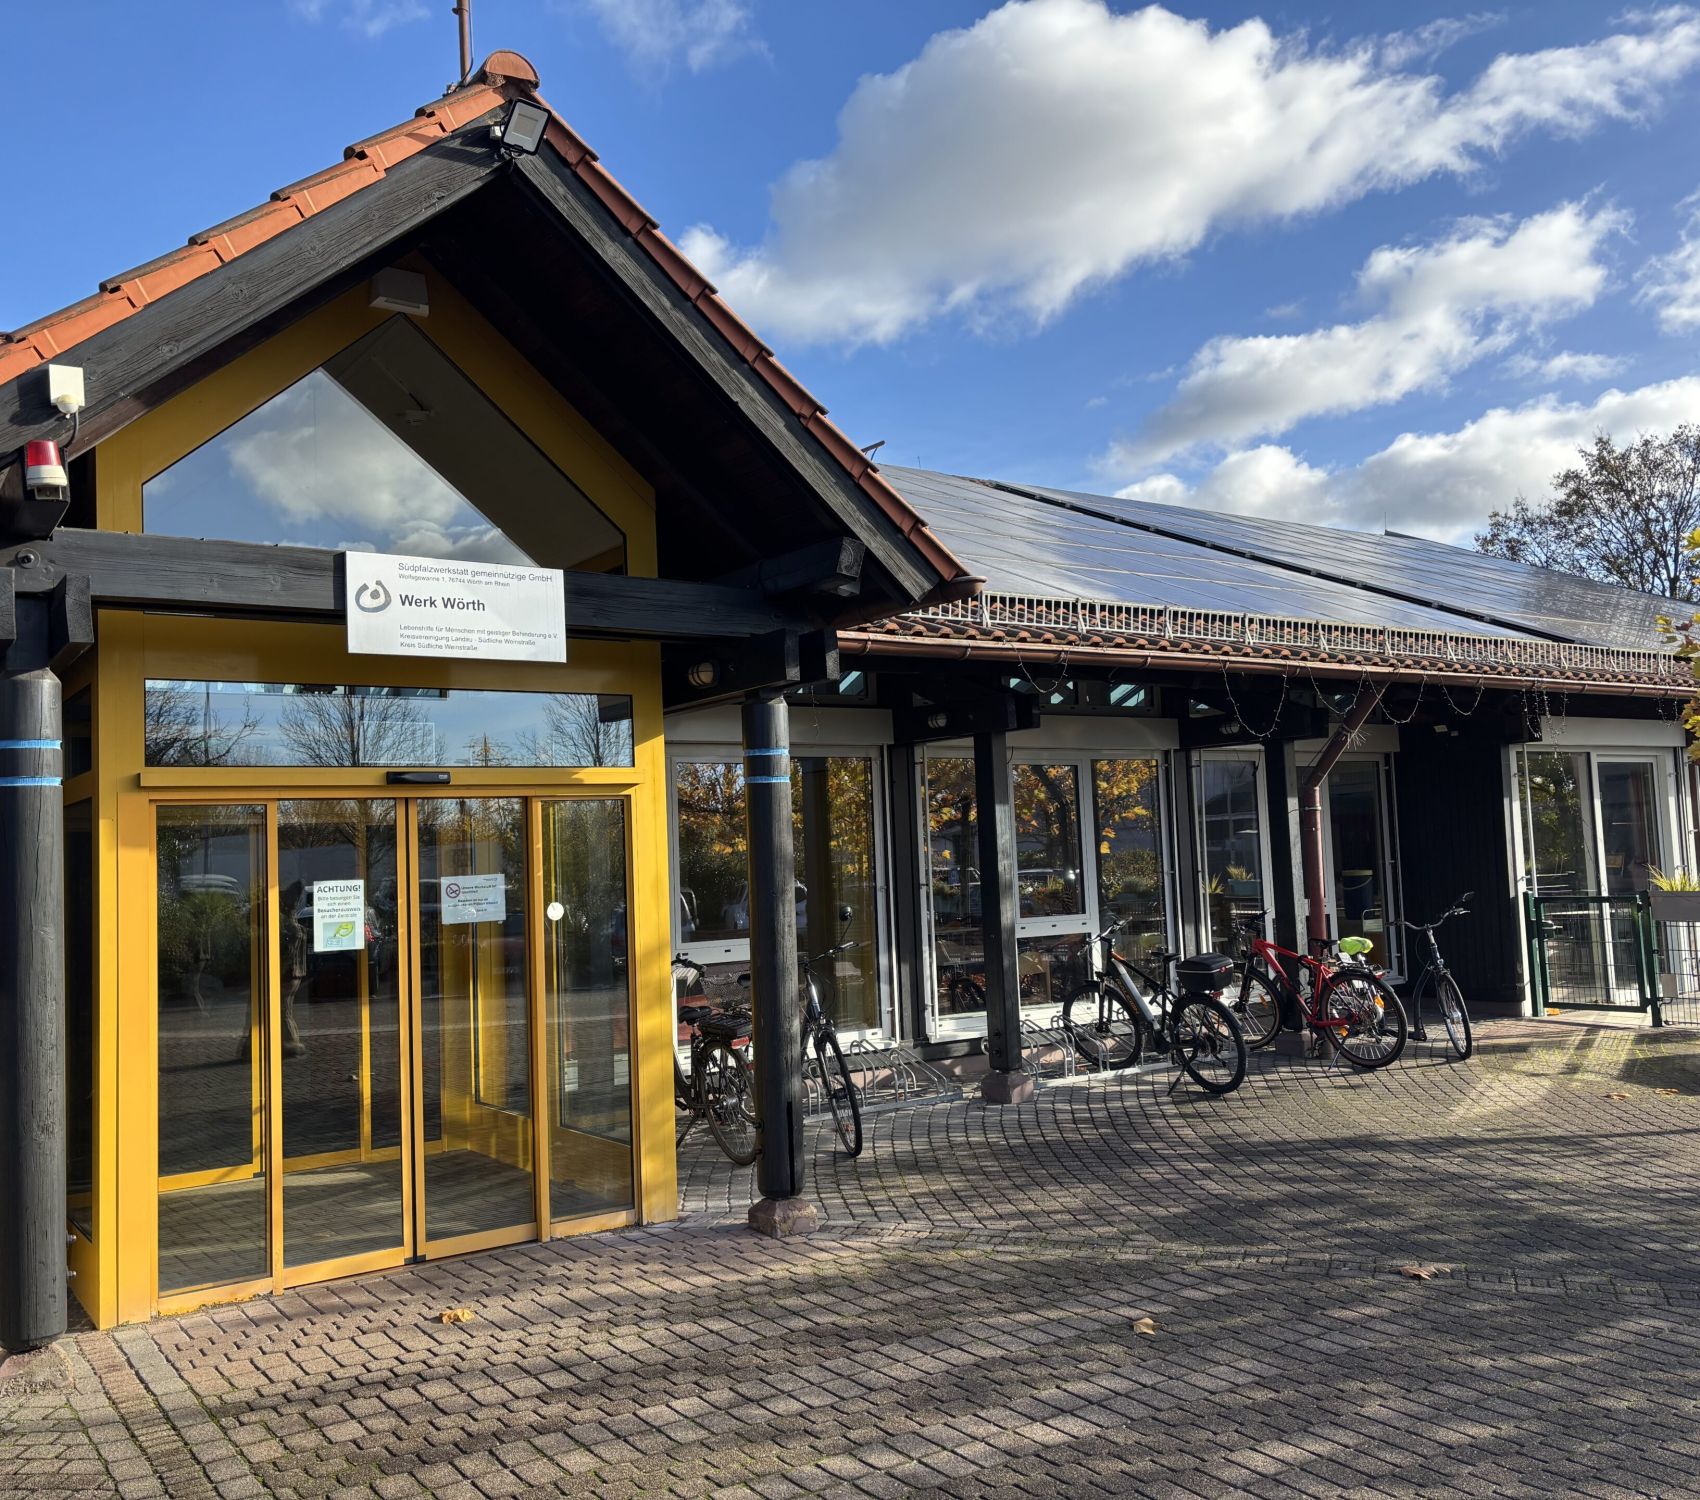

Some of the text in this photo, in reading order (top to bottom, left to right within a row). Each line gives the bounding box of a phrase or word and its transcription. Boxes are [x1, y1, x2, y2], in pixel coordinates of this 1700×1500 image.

[398, 563, 553, 582] Südpfalzwerkstatt gemeinnützige GmbH
[400, 593, 486, 611] Werk Wörth
[400, 624, 435, 632] Lebenshilfe
[445, 626, 475, 634] Menschen
[486, 630, 511, 638] geistiger
[512, 630, 547, 640] Behinderung
[400, 633, 450, 642] Kreisvereinigung
[503, 638, 536, 646] Weinstraße
[417, 642, 443, 650] Südliche
[444, 643, 478, 651] Weinstraße
[316, 884, 361, 893] ACHTUNG!
